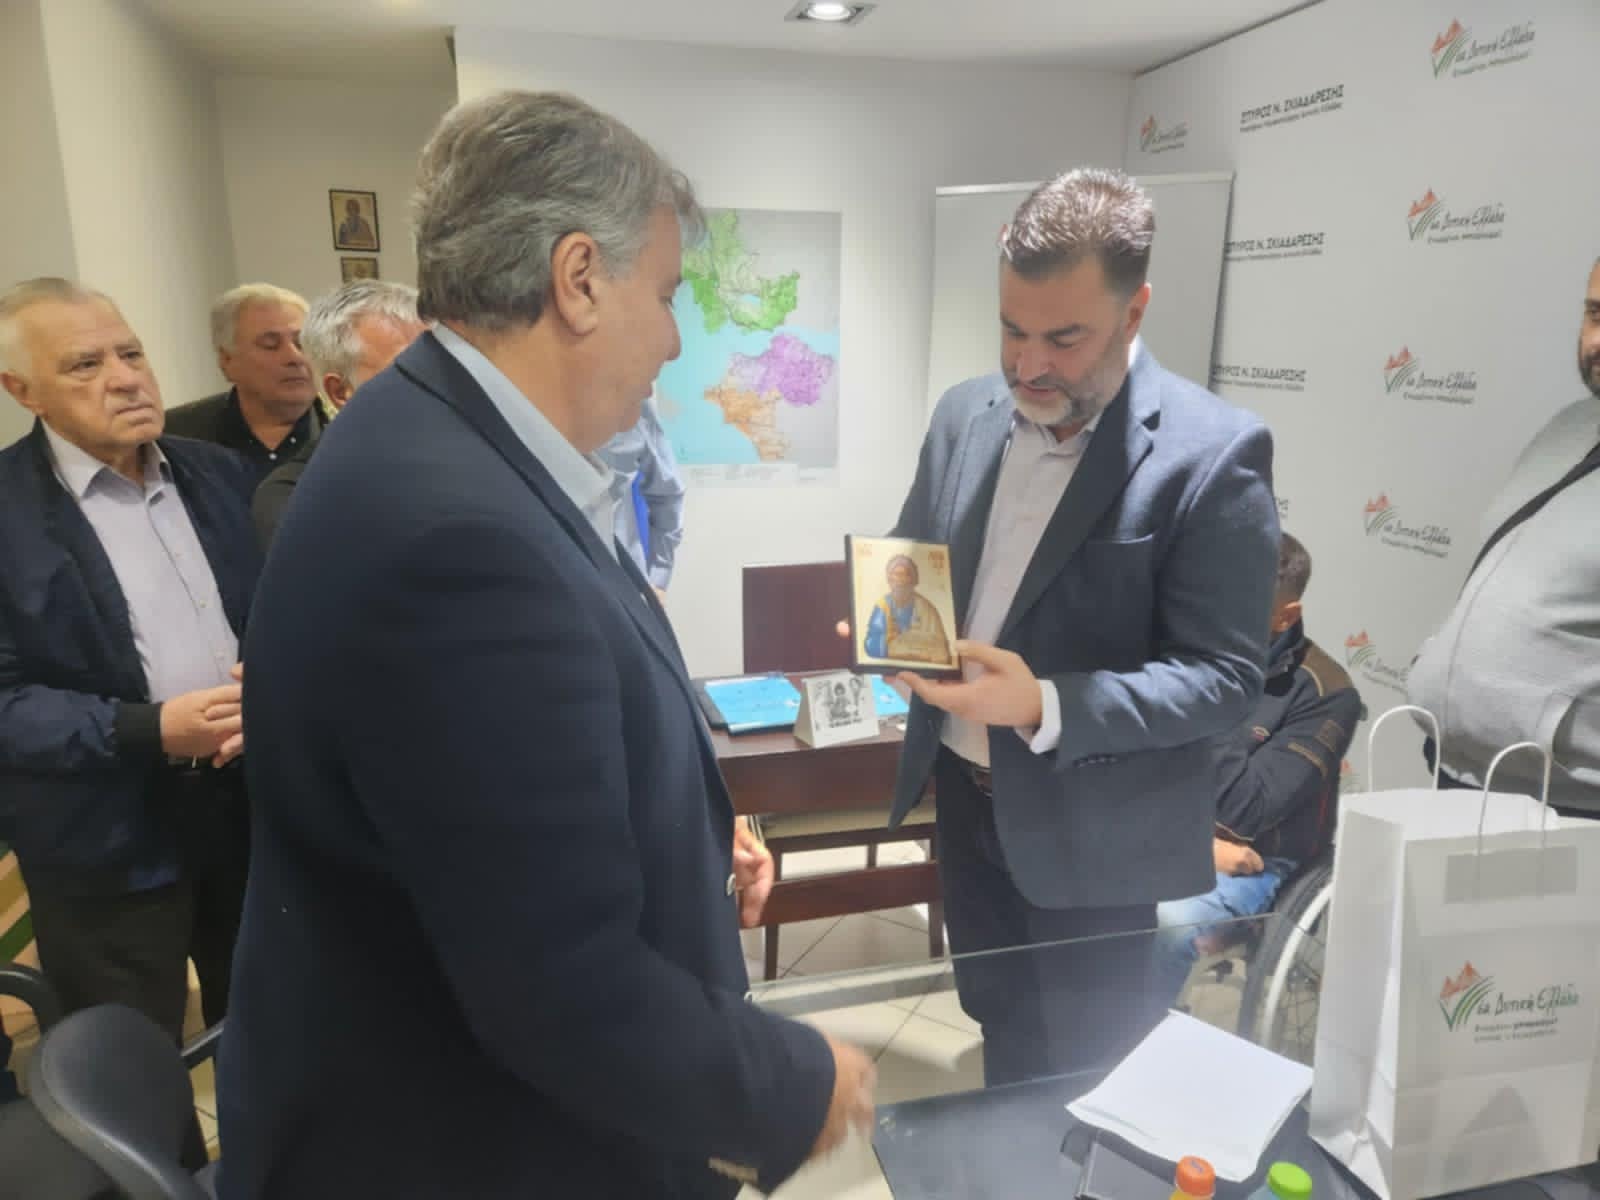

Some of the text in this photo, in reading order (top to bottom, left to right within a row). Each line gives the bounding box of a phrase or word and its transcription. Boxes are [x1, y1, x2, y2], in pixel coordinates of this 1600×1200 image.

[1240, 103, 1272, 125] ΣΠΥΡΟΣ
[1283, 83, 1344, 113] ΣΚΙΑΔΑΡΕΣΗΣ
[1265, 231, 1326, 250] ΣΚΙΑΔΑΡΕΣΗΣ
[1251, 366, 1307, 383] ΣΚΙΑΔΑΡΕΣΗΣ
